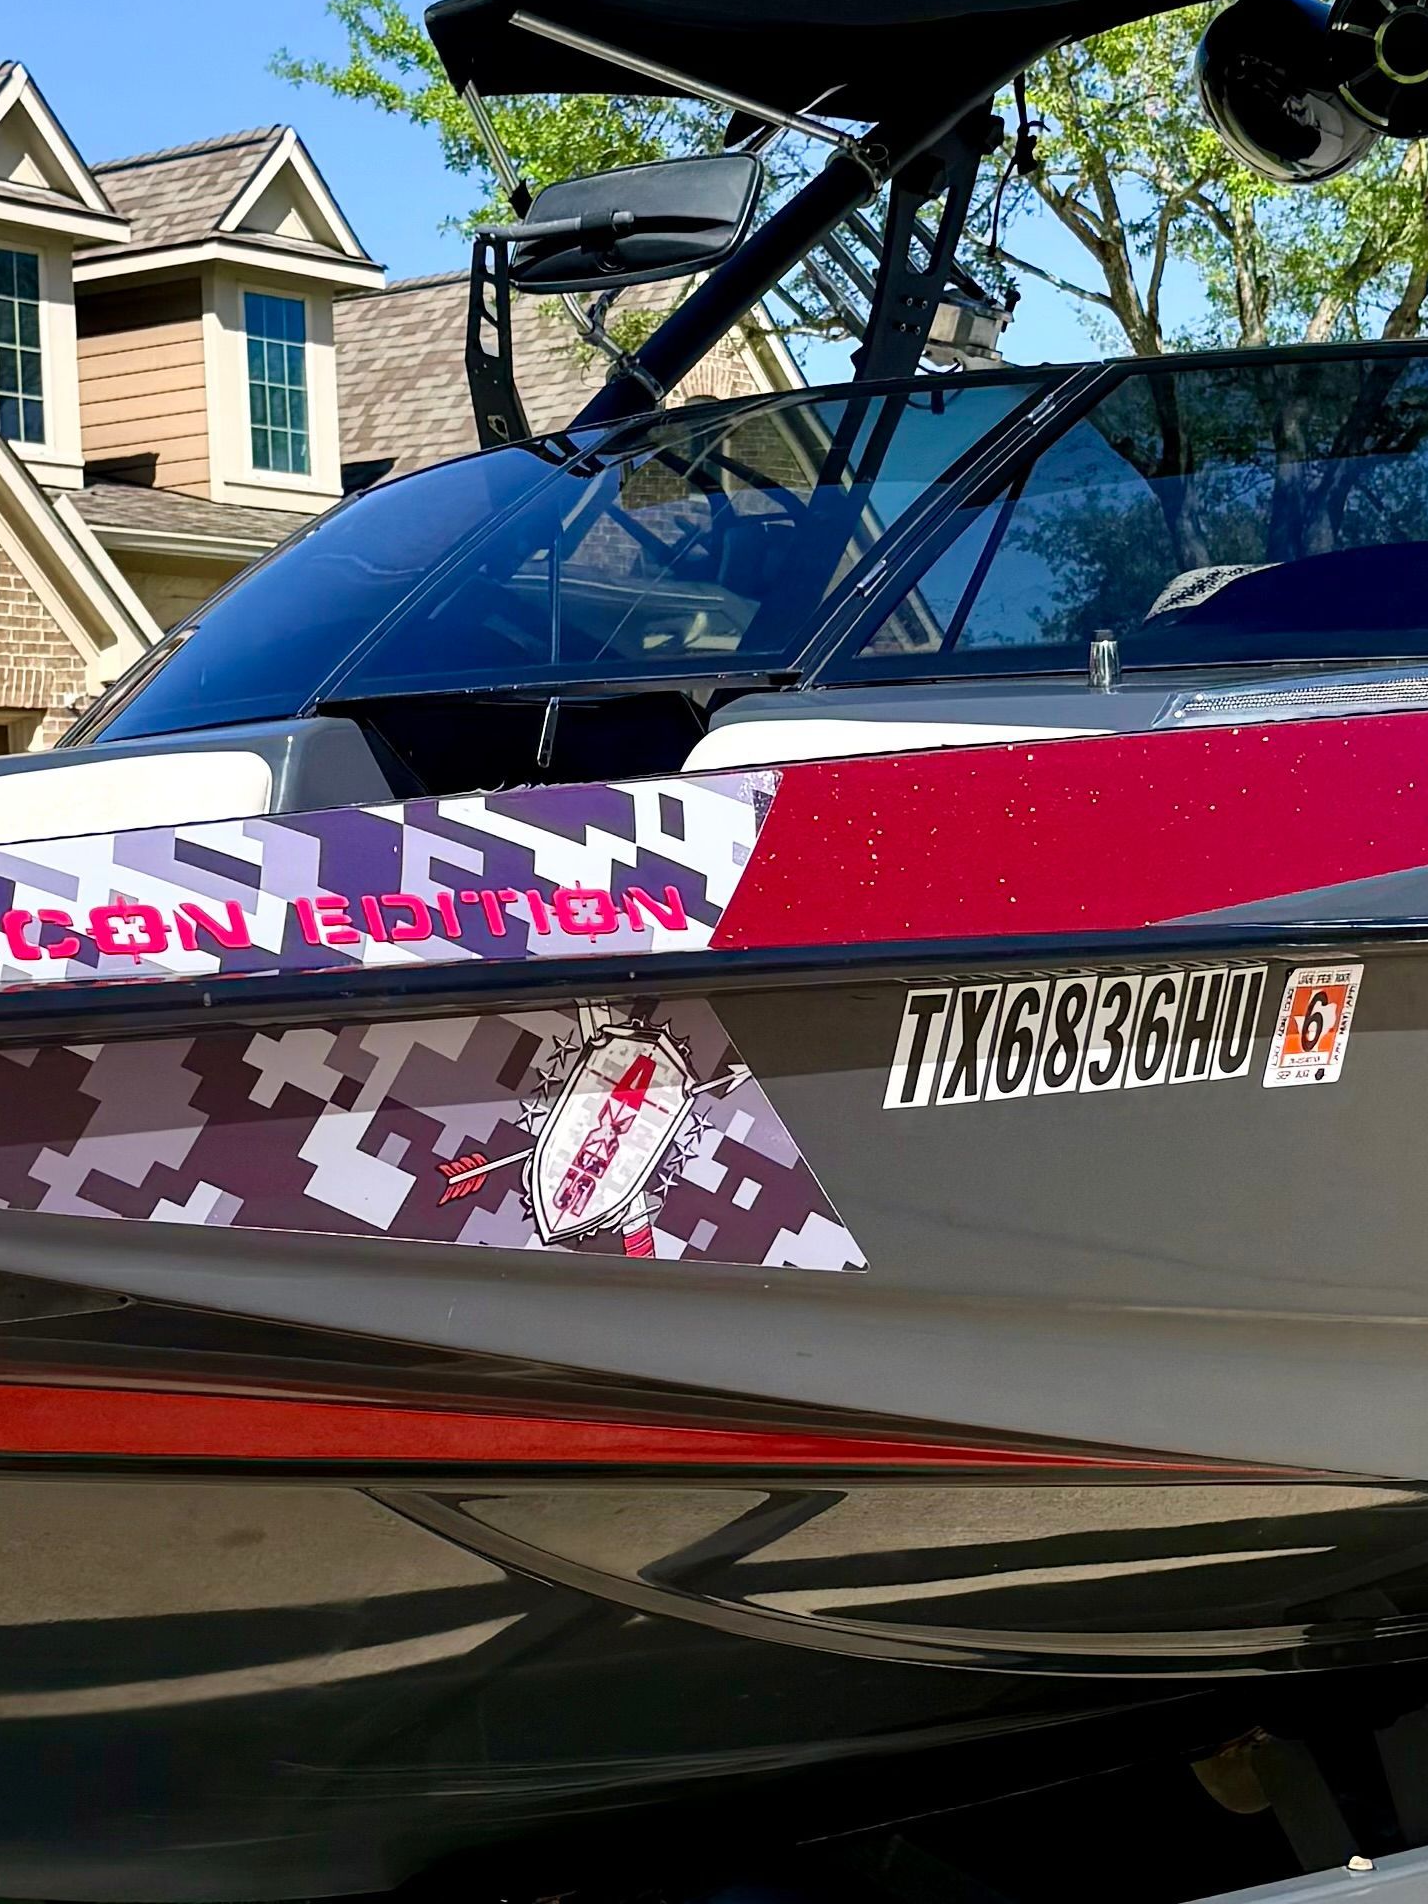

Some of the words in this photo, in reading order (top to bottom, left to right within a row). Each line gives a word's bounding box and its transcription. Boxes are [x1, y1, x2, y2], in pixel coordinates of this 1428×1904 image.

[295, 880, 689, 945] EDITION
[899, 970, 1266, 1104] TX6836HU
[1301, 991, 1329, 1053] 6
[552, 1053, 658, 1218] AXIS
